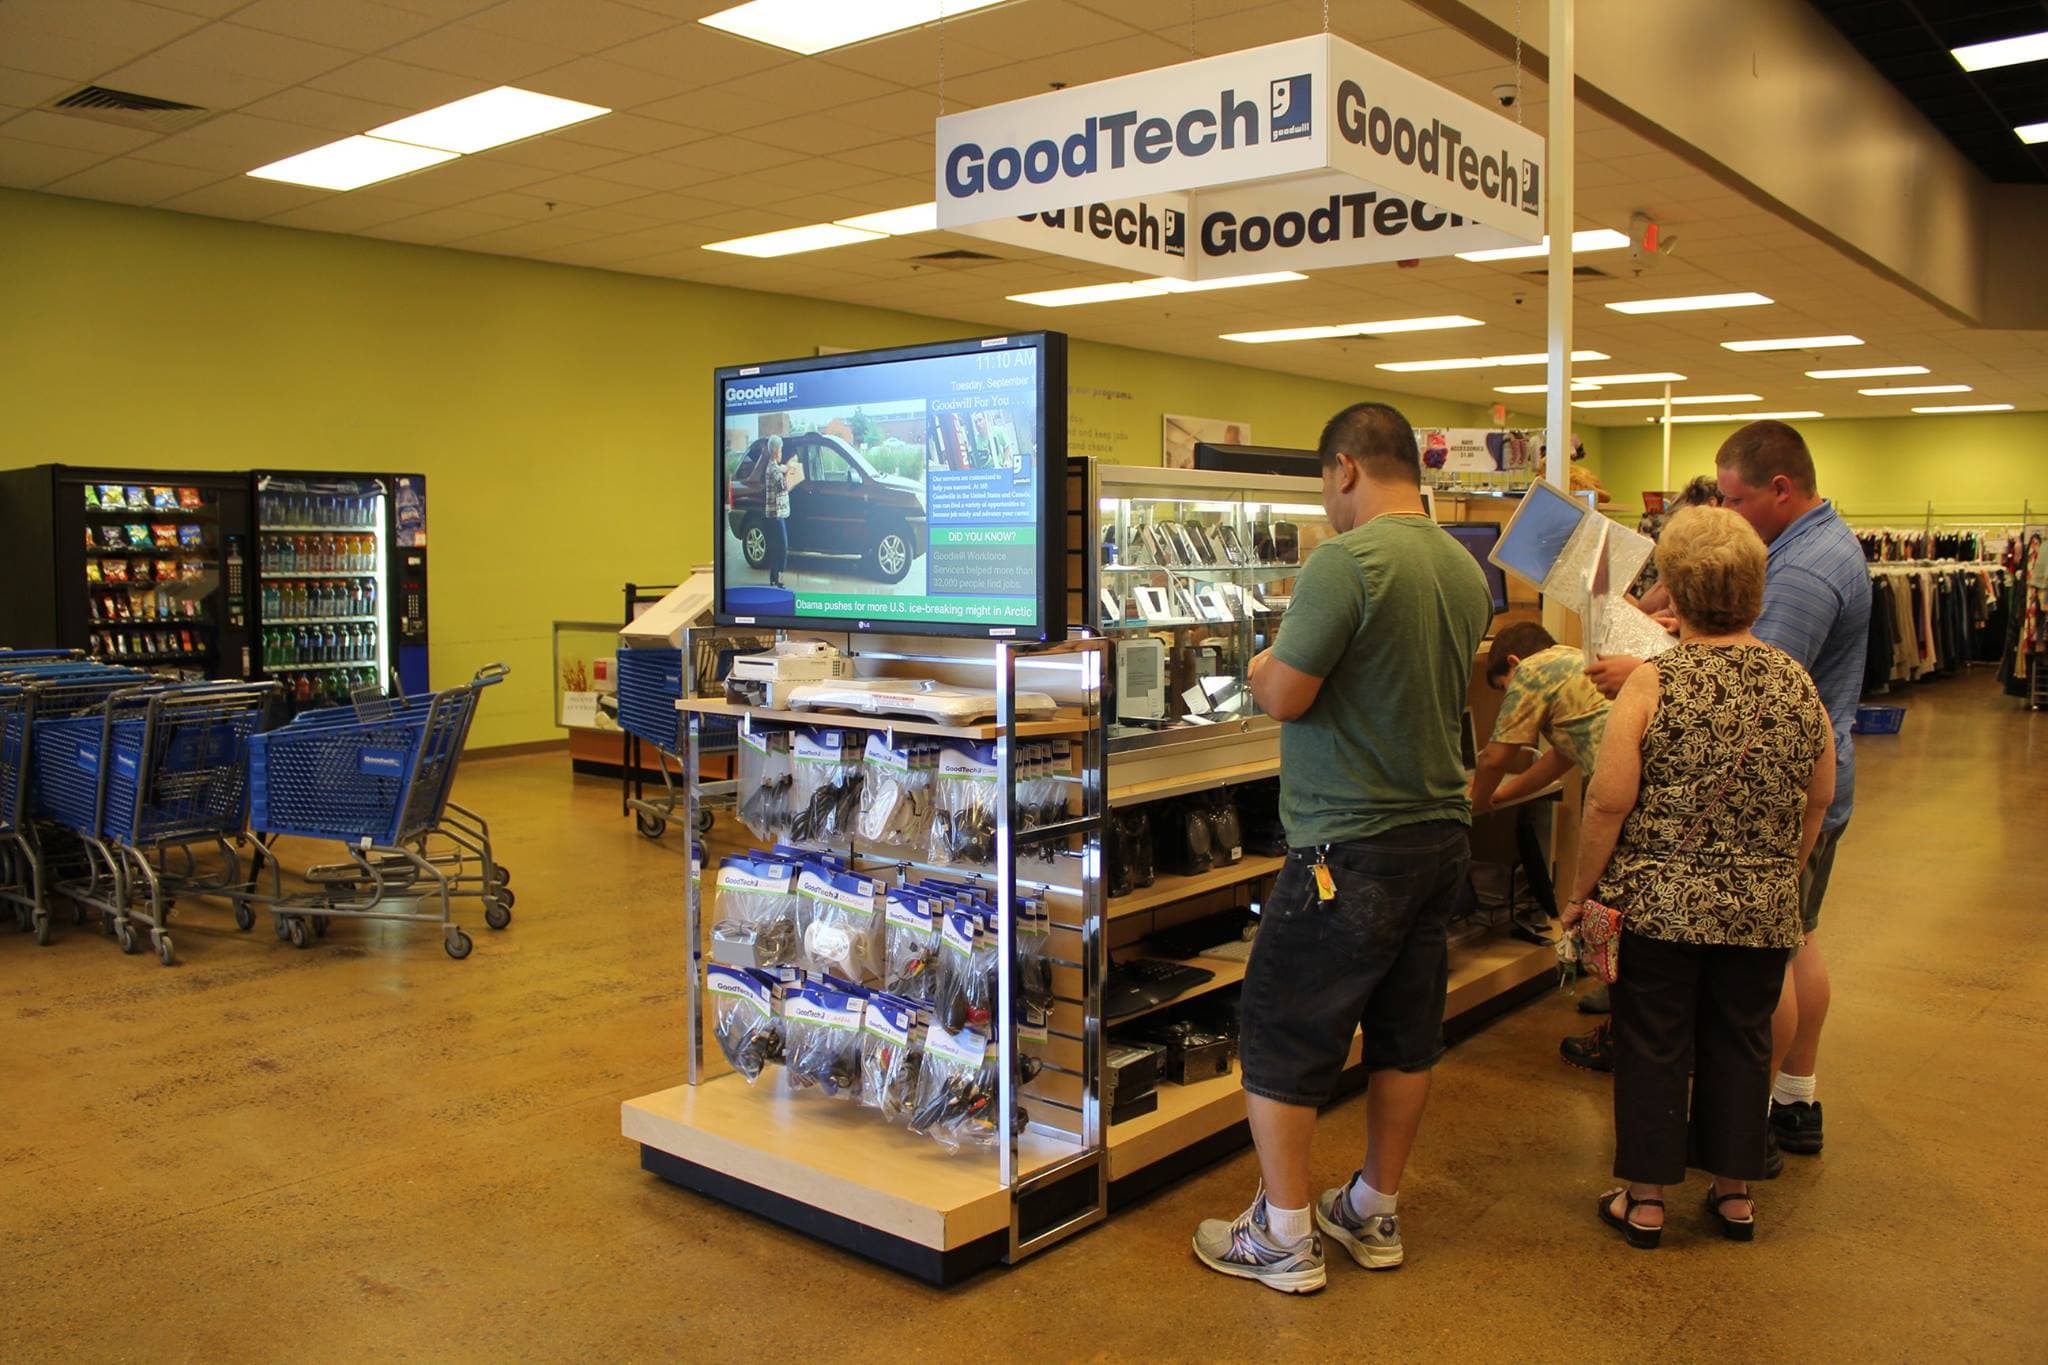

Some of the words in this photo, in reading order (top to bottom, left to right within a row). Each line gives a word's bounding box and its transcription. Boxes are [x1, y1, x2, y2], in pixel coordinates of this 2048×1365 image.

[1272, 122, 1310, 141] goodwill
[945, 88, 1259, 198] GoodTech
[1336, 79, 1518, 207] GoodTech
[1200, 191, 1481, 257] GoodTec
[725, 382, 788, 402] Goodwill
[951, 380, 985, 392] Tuesday,
[986, 375, 1030, 389] September
[931, 396, 972, 411] Goodwill
[974, 396, 990, 408] For
[991, 394, 1009, 407] You
[948, 531, 963, 542] DID
[965, 531, 983, 541] YOU
[984, 531, 1017, 541] KNOW?
[933, 551, 966, 561] Goodwill
[967, 551, 1007, 561] Workforce
[933, 565, 965, 575] Services
[966, 565, 992, 577] helped
[994, 567, 1014, 575] more
[1015, 566, 1033, 575] than
[795, 599, 823, 610] Obama
[824, 600, 853, 612] pushes
[854, 600, 866, 611] for
[867, 602, 888, 612] more
[889, 601, 907, 612] U.S.
[909, 602, 963, 617] ice-breaking
[965, 604, 992, 618] might
[993, 605, 1002, 616] in
[1004, 605, 1033, 617] Arctic
[945, 765, 977, 774] GoodTech
[725, 876, 755, 887] GoodTech
[803, 882, 835, 899] GoodTech
[717, 982, 750, 997] GoodTech
